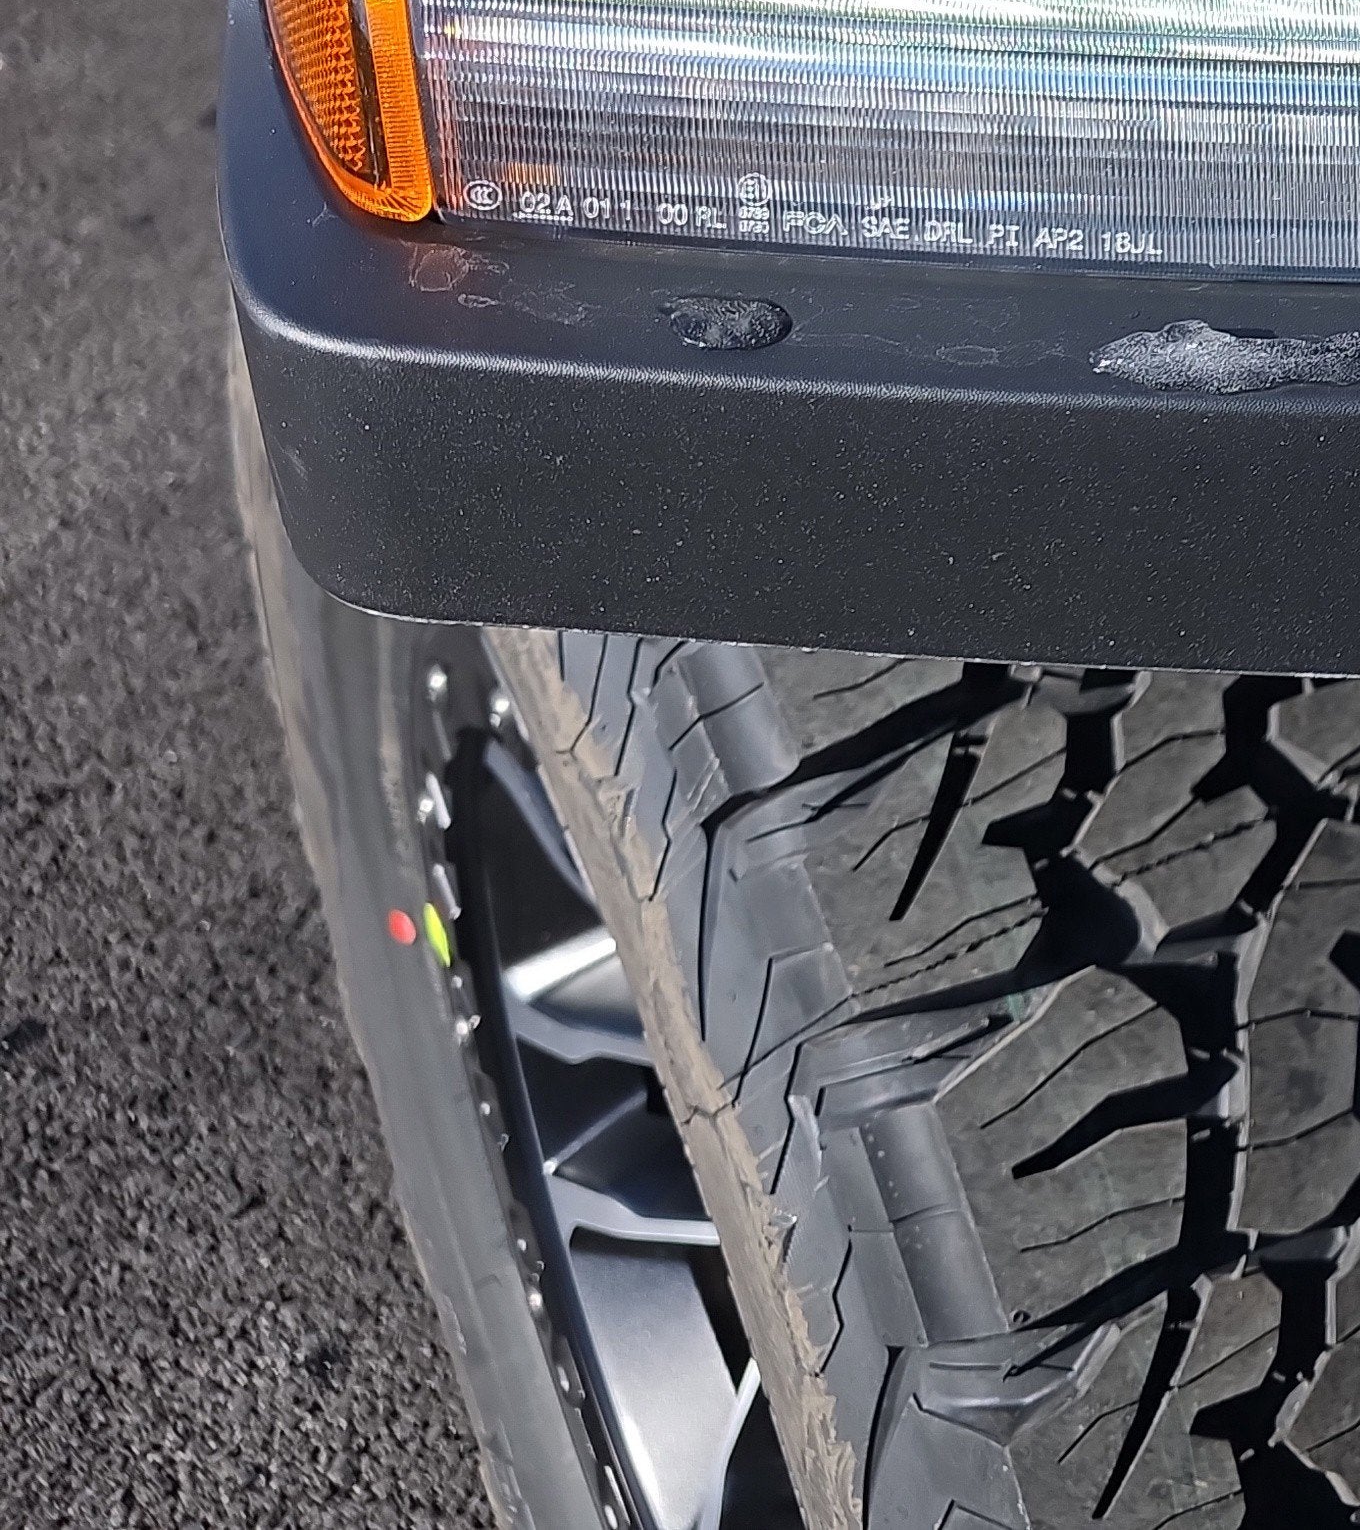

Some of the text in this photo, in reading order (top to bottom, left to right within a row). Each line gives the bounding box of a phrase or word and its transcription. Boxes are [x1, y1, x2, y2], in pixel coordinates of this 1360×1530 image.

[657, 202, 689, 226] 00
[782, 210, 848, 237] FCA
[862, 215, 910, 240] SAE
[924, 219, 974, 244] DRL
[1032, 226, 1084, 252] AP2
